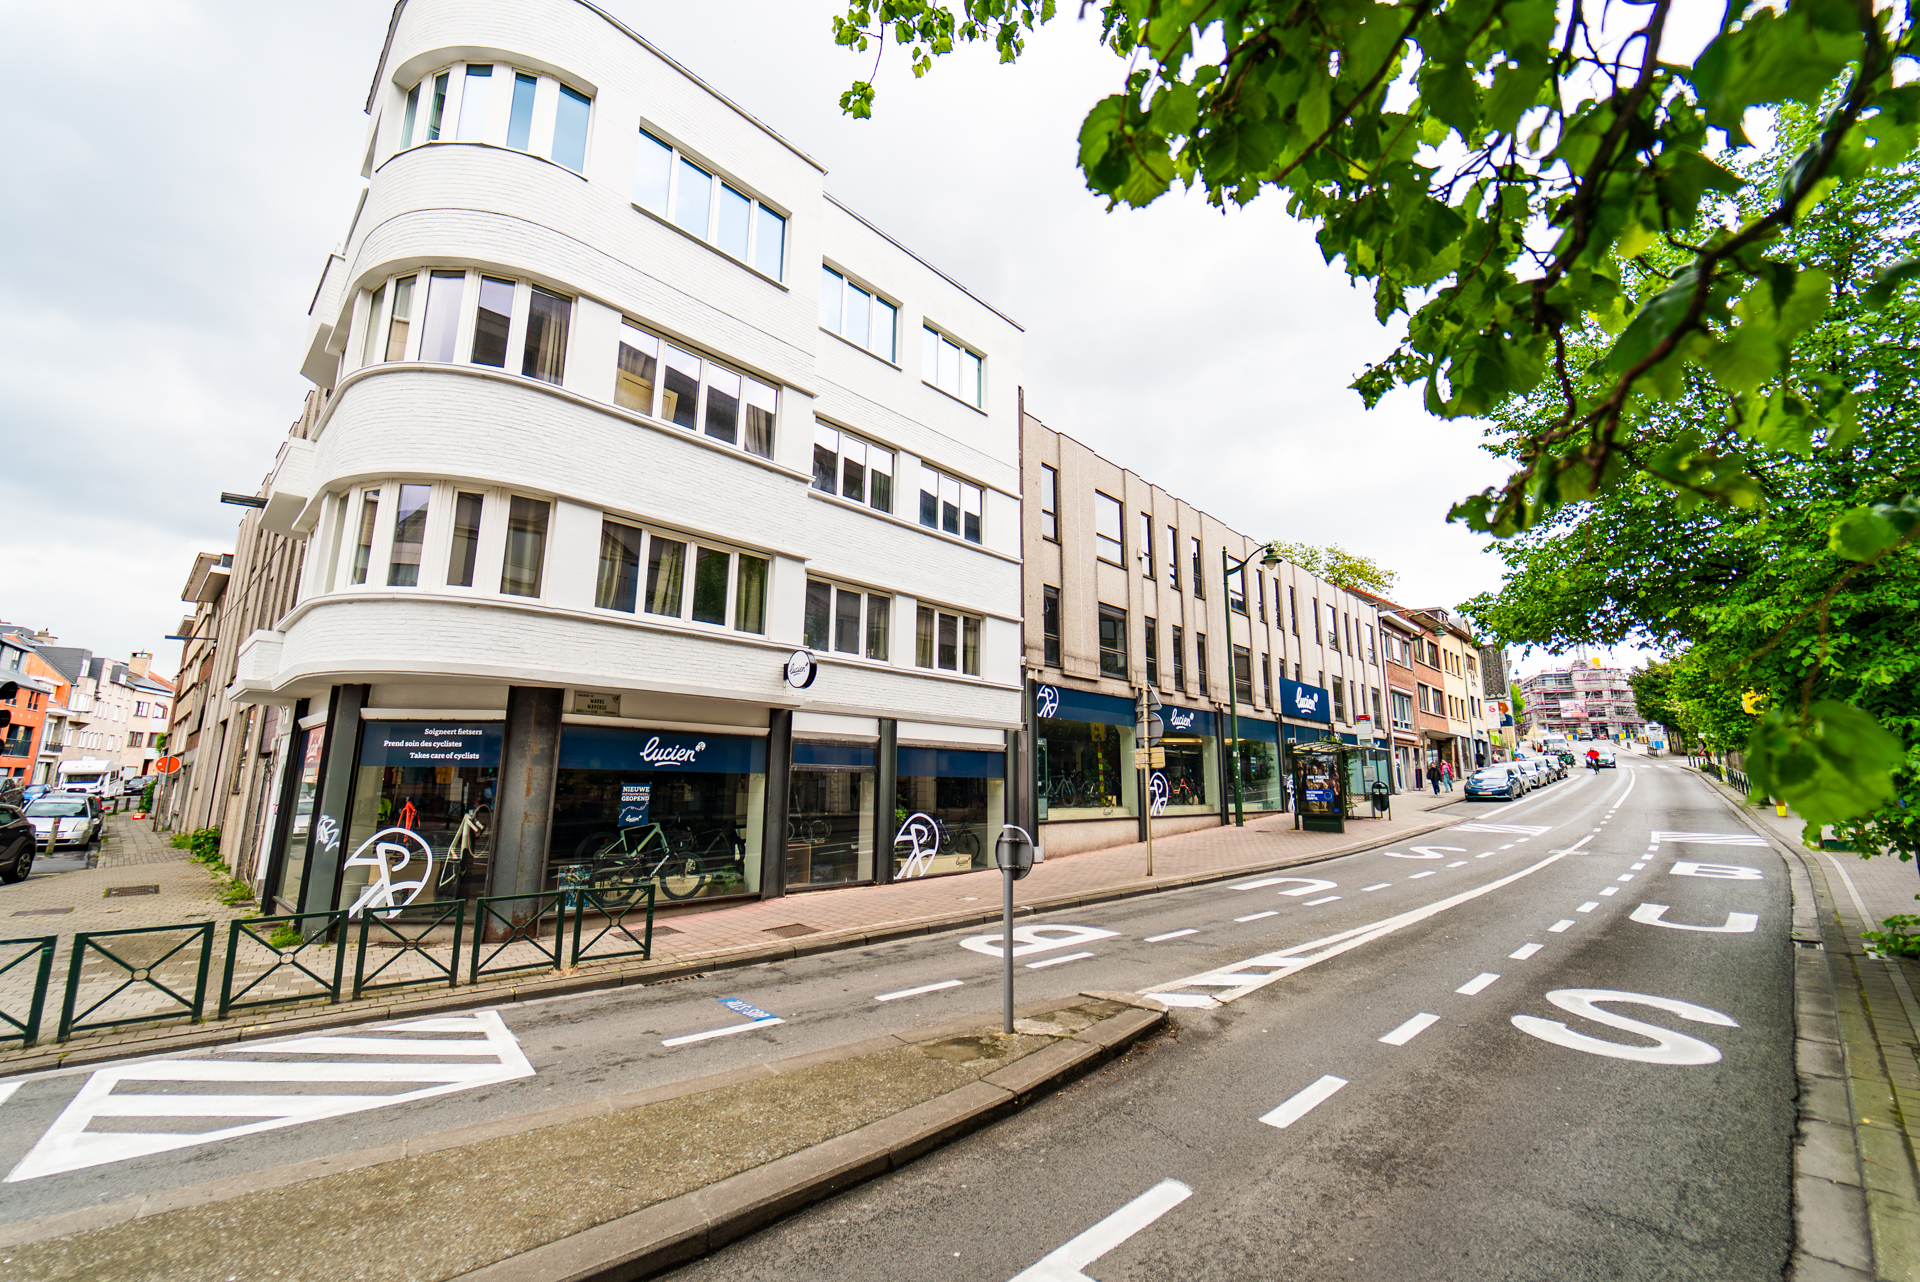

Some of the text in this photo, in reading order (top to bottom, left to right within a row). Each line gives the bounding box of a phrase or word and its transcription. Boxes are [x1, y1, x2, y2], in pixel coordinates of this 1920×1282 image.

[424, 728, 457, 736] Soigneert
[432, 740, 463, 748] cyclistes
[454, 752, 480, 760] cyclists
